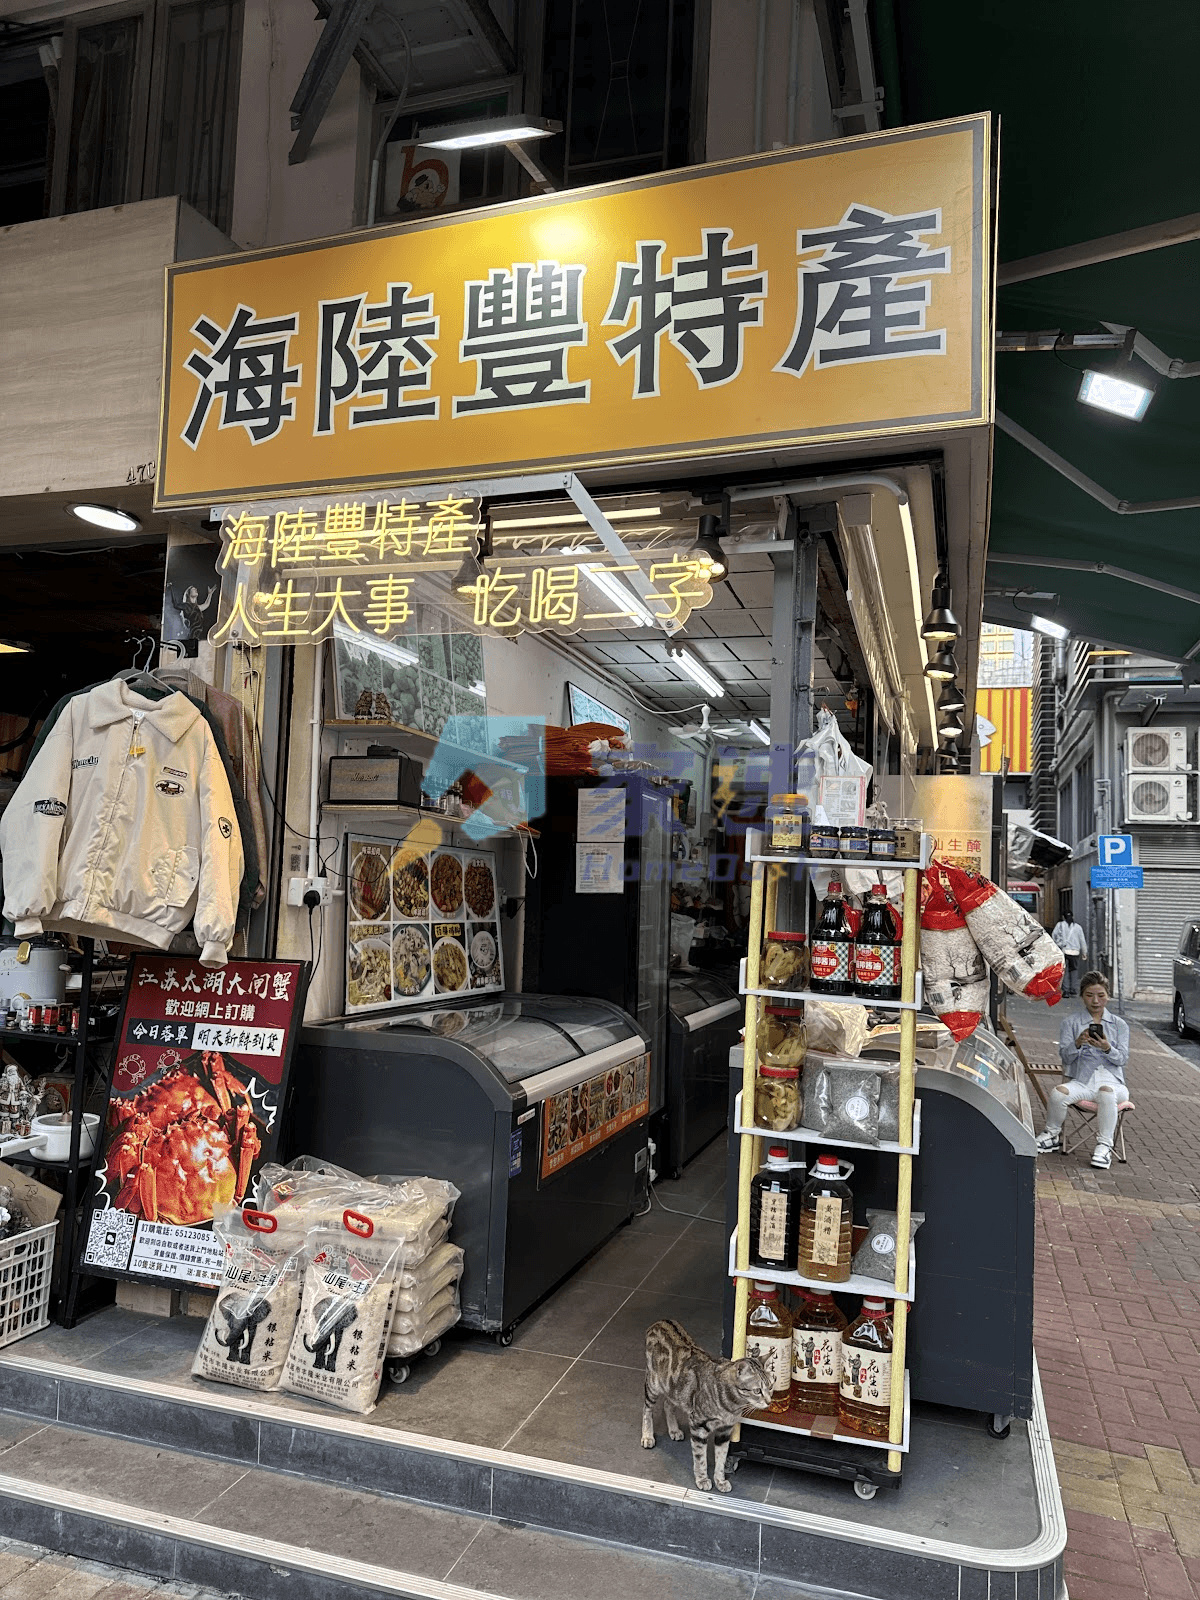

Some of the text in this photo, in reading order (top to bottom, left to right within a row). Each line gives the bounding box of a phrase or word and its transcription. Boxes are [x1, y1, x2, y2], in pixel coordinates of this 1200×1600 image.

[179, 202, 952, 449] 海陸豐特產
[221, 493, 475, 569] 海陸豐特產
[213, 552, 715, 640] 人生大事 吃喝二字
[1104, 837, 1127, 864] P
[165, 998, 256, 1022] 歡迎網上訂購
[132, 1021, 189, 1045] 今日落單
[174, 1230, 211, 1243] 65123085
[820, 1338, 834, 1377] 花生油
[866, 1358, 880, 1399] 花生油
